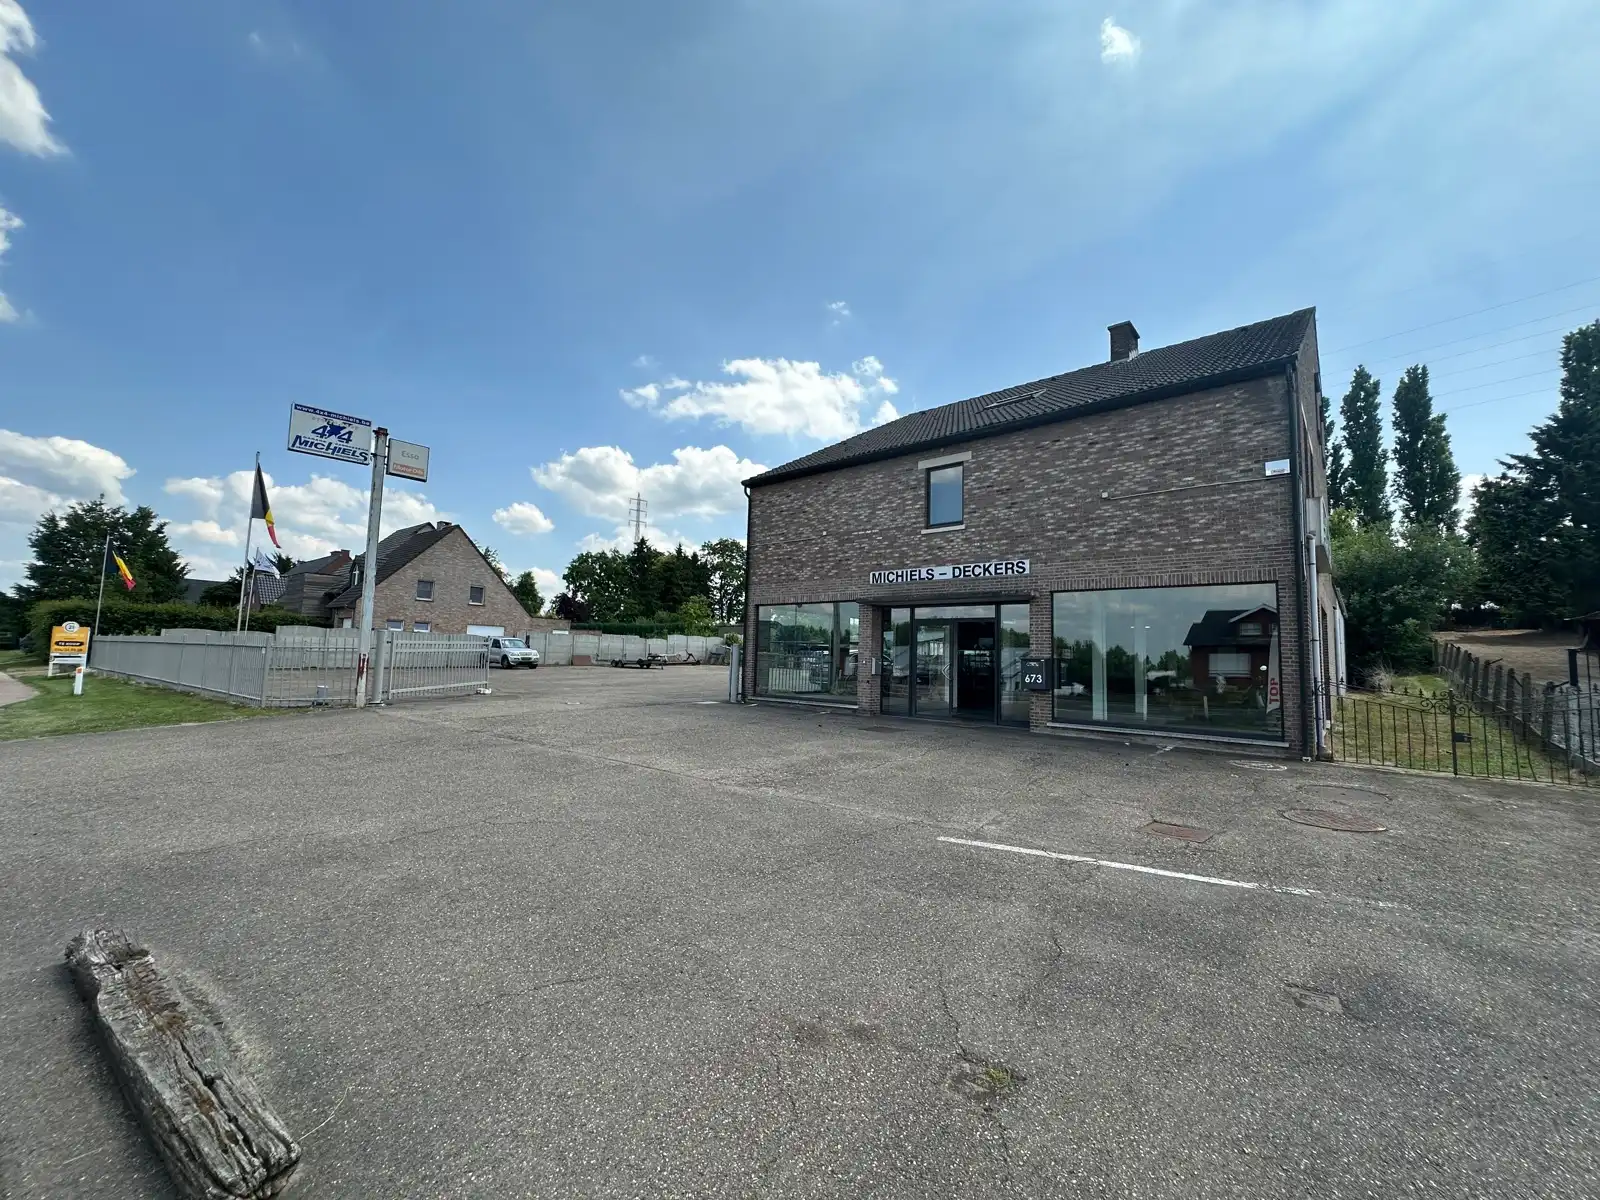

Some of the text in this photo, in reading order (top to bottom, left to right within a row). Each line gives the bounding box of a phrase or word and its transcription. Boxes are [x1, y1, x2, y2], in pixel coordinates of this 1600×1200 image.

[296, 404, 370, 426] www.4x4-michiels.be
[291, 434, 368, 462] MICHIELS
[872, 568, 934, 584] MICHIELS
[952, 561, 1026, 579] DECKERS
[1025, 674, 1043, 684] 673
